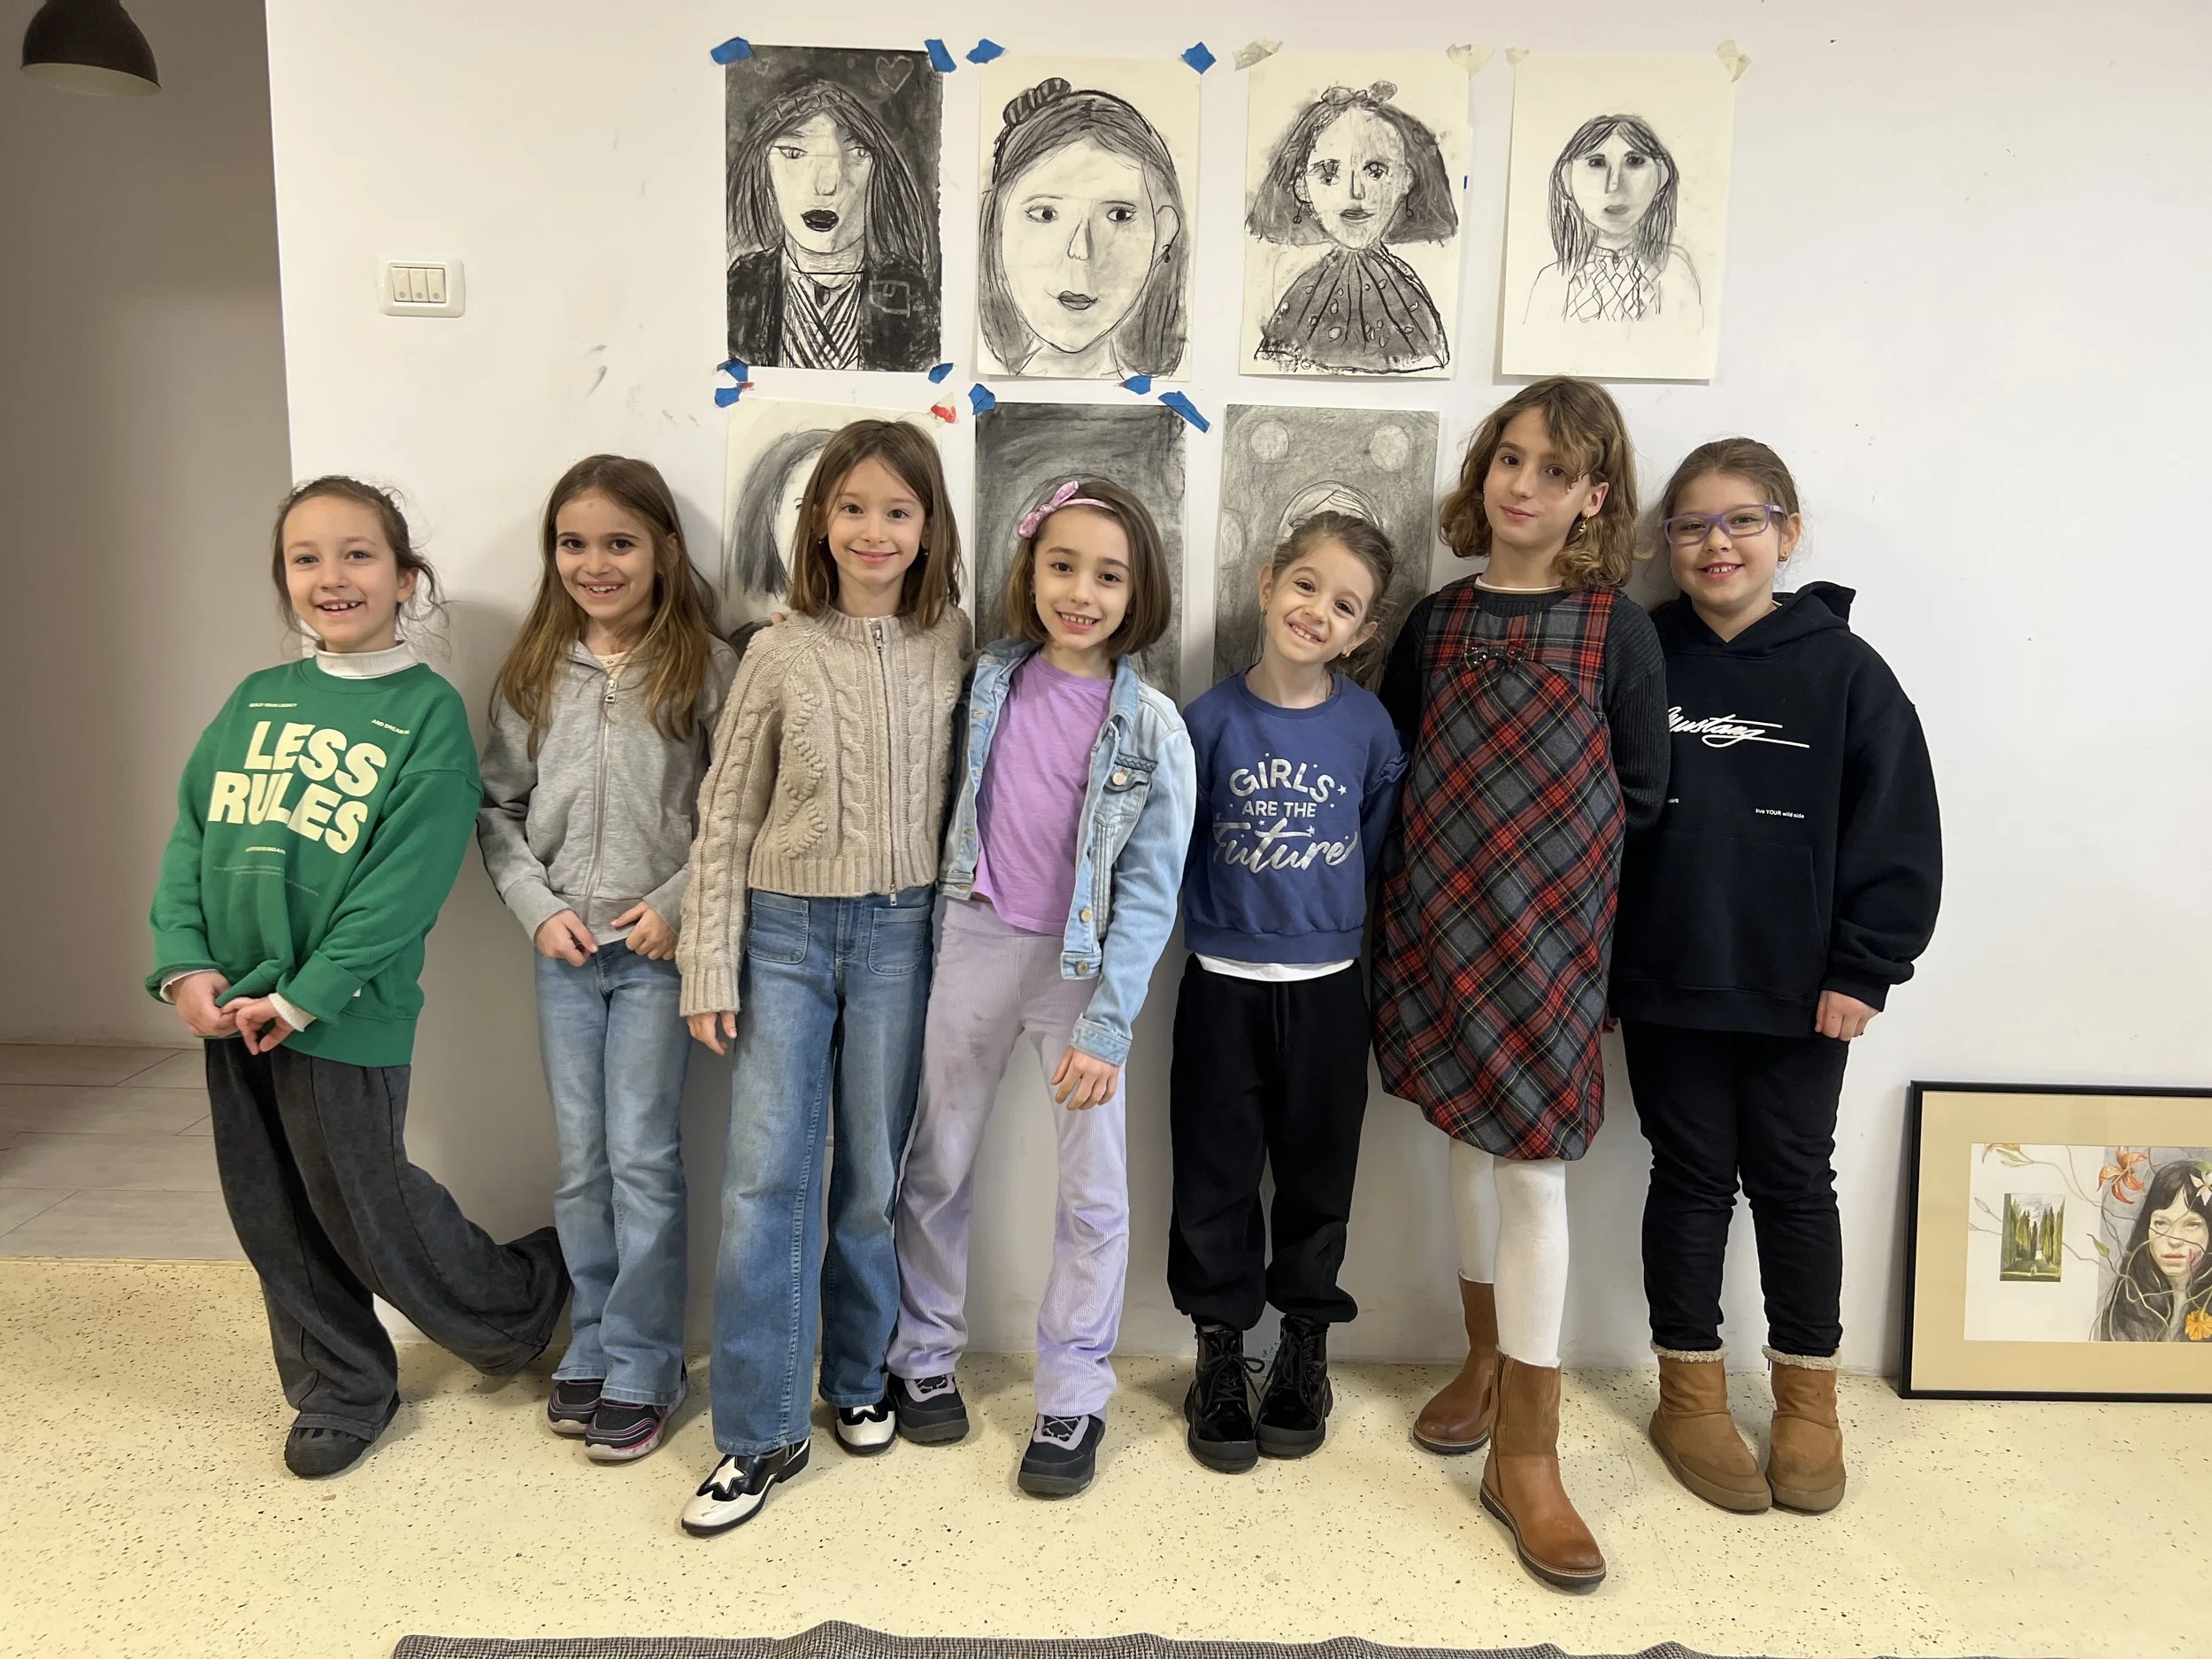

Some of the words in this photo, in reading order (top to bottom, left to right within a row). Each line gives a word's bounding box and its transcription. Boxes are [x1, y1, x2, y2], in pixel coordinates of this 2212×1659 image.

[243, 720, 387, 797] LESS
[207, 771, 368, 854] RULES
[1241, 800, 1278, 817] ARE
[1283, 802, 1317, 818] THE
[1212, 818, 1358, 873] Future
